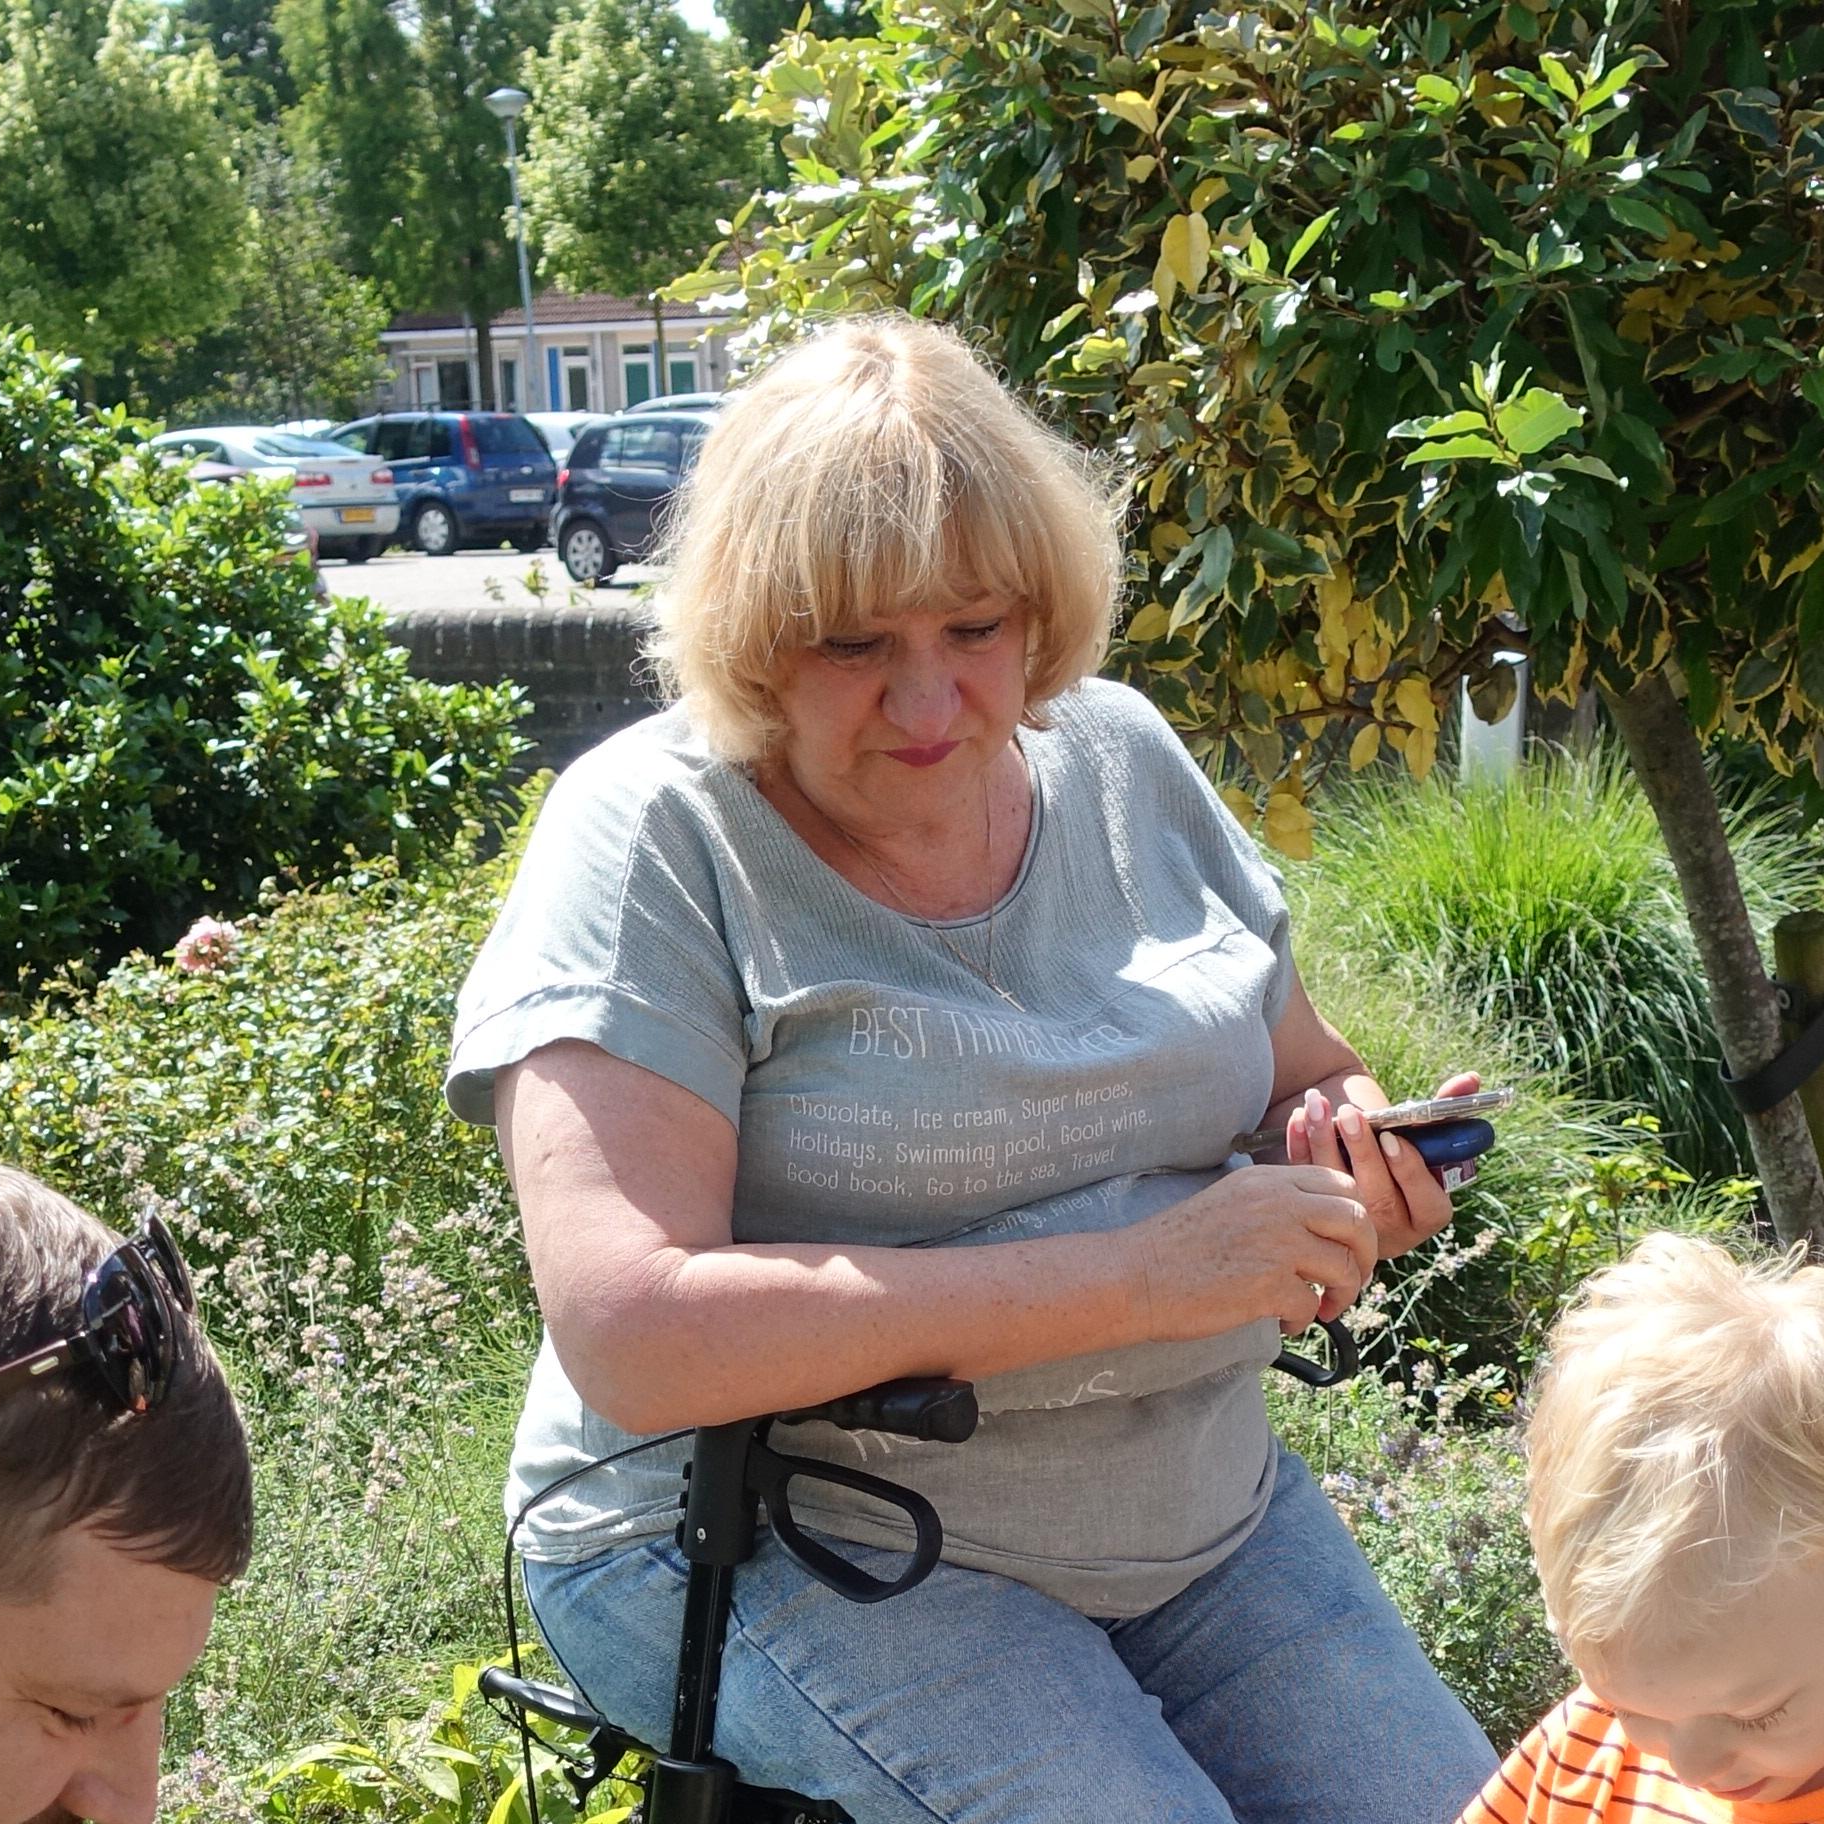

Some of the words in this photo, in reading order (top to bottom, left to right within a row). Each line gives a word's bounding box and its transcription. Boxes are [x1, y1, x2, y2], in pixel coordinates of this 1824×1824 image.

[849, 1006, 929, 1060] BEST
[942, 1008, 1057, 1062] THINGS
[790, 1094, 899, 1132] Chocolate,
[913, 1107, 942, 1129] Ice
[953, 1105, 1013, 1128] cream,
[1021, 1092, 1067, 1124] Super
[1075, 1080, 1133, 1108] heroes,
[789, 1127, 882, 1168] Holidays,
[896, 1142, 995, 1169] Swimming
[1004, 1129, 1051, 1165] pool,
[1060, 1118, 1104, 1146] Good
[1111, 1107, 1153, 1135] wine,
[787, 1162, 839, 1190] Good
[849, 1171, 913, 1198] book,
[926, 1172, 954, 1197] Go
[964, 1172, 988, 1194] to
[996, 1161, 1023, 1189] the
[1029, 1160, 1061, 1182] sea,
[1071, 1145, 1117, 1172] Travel
